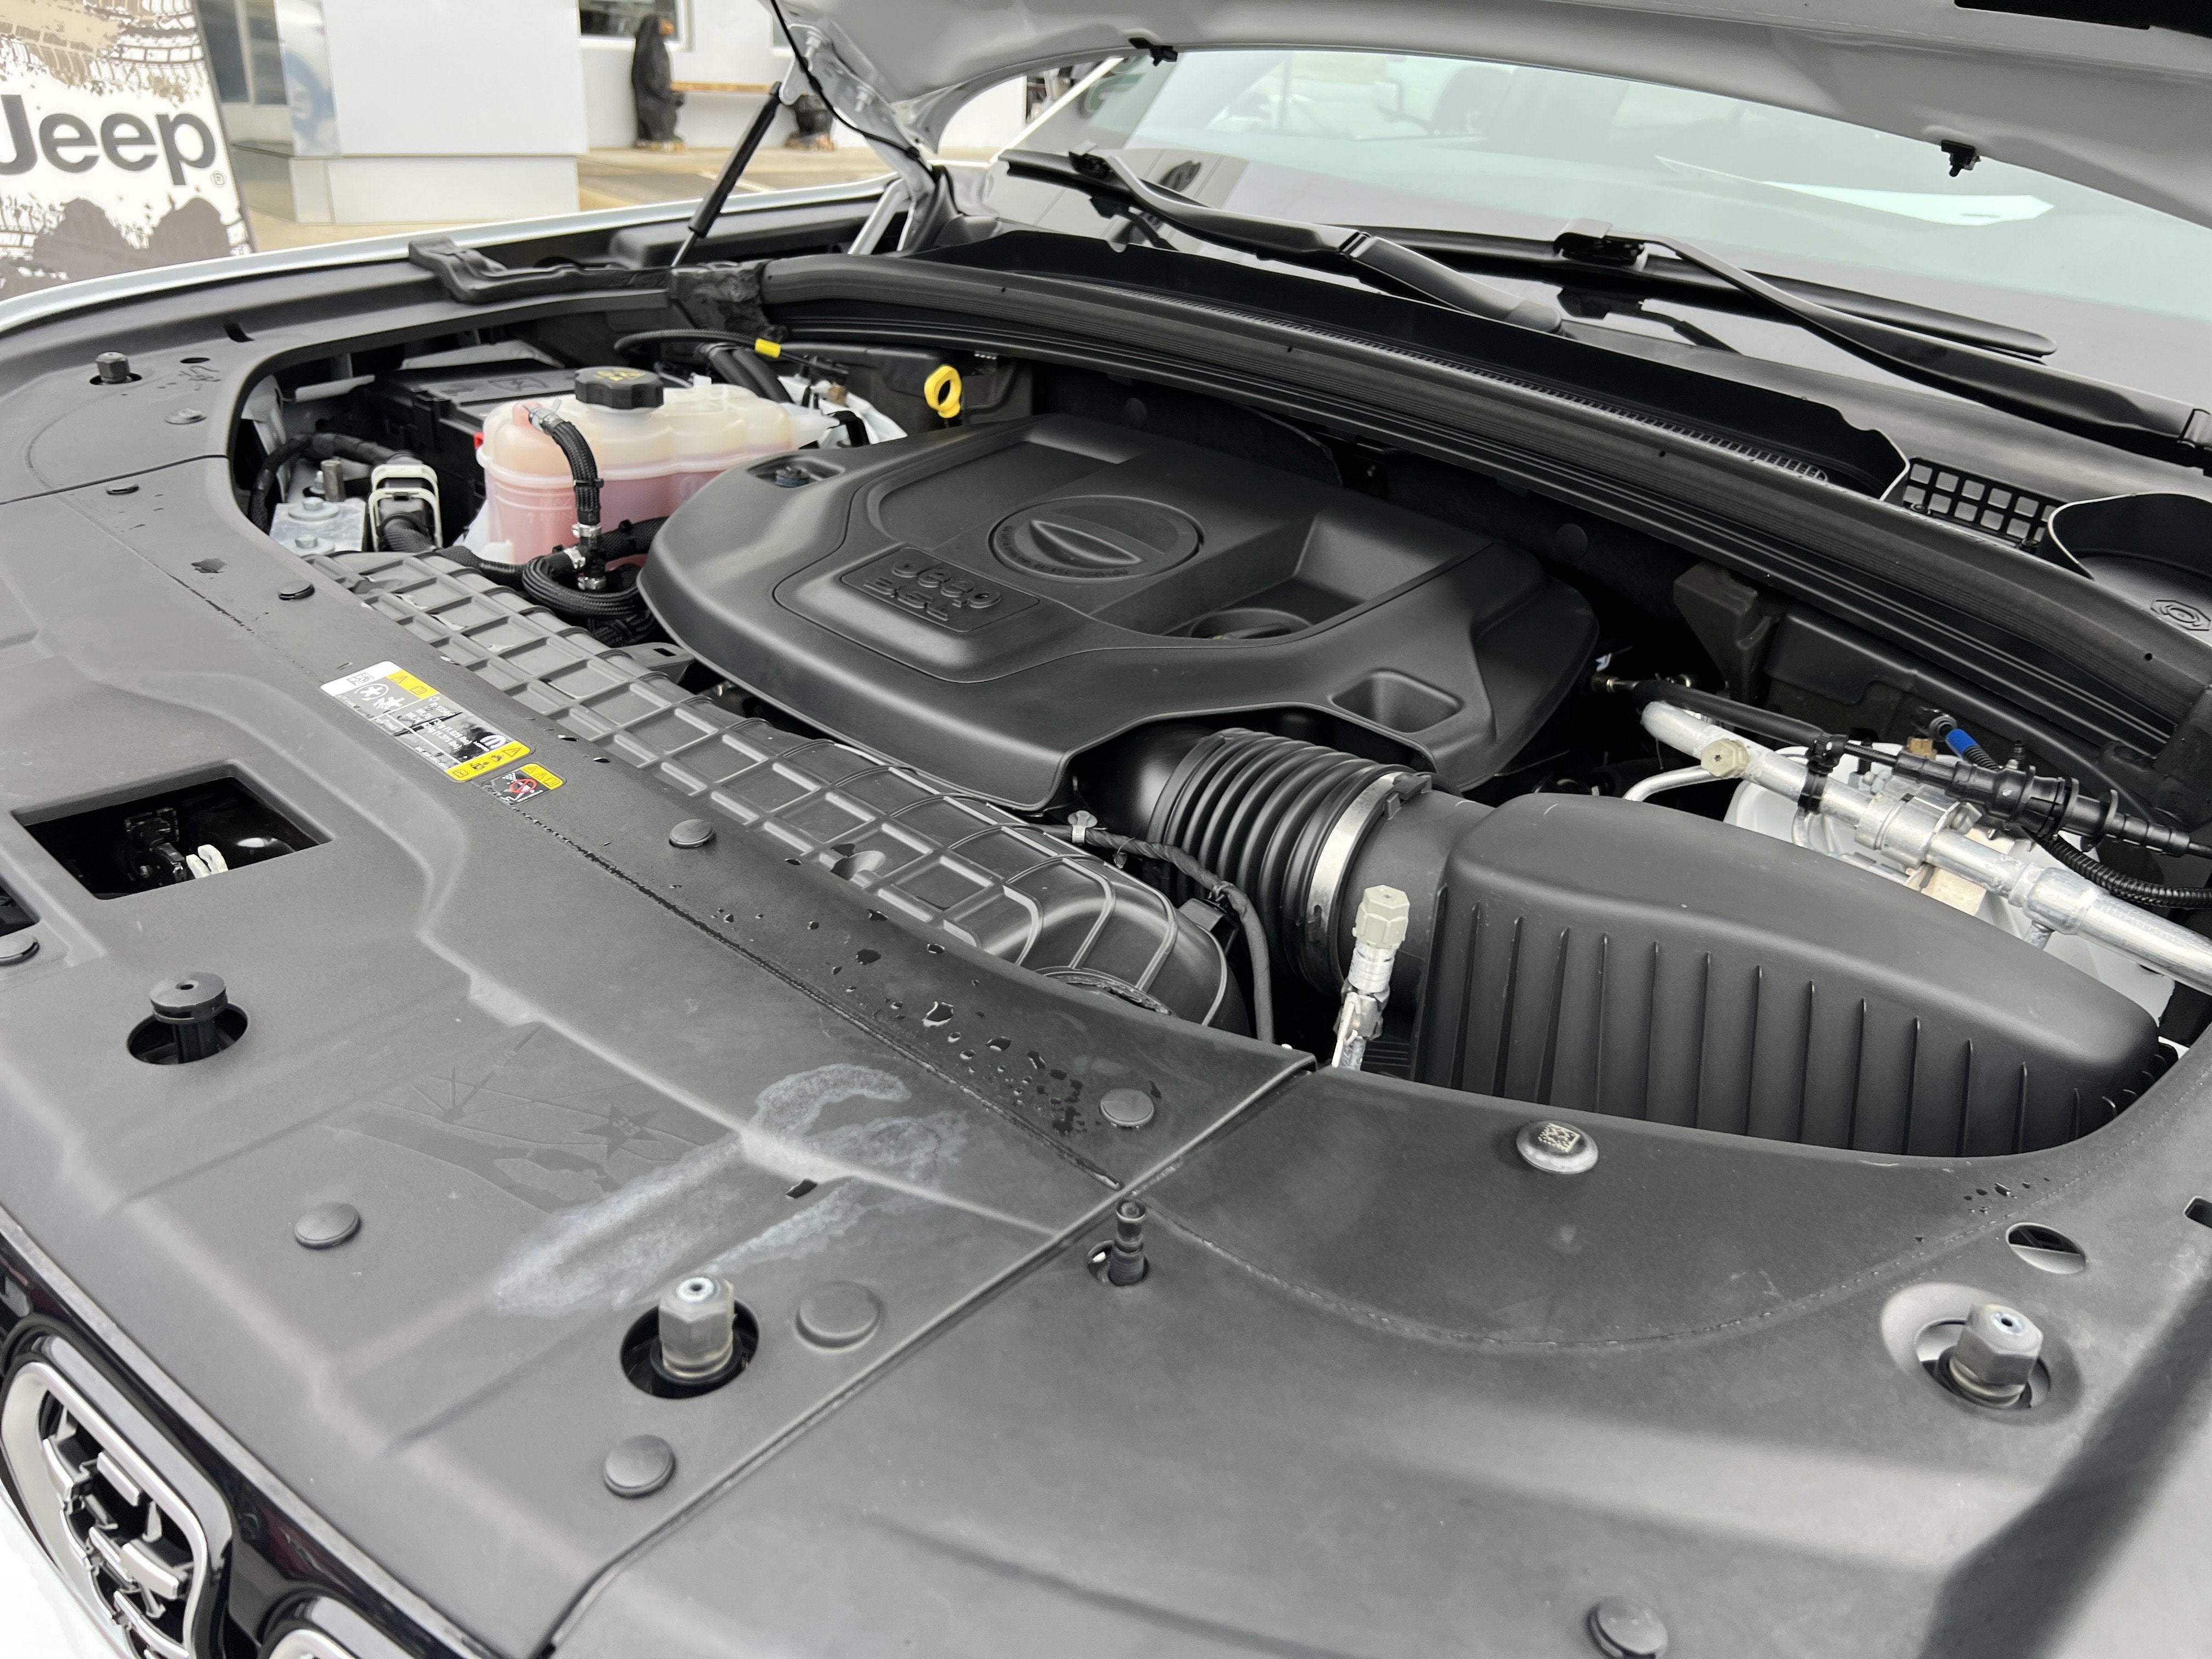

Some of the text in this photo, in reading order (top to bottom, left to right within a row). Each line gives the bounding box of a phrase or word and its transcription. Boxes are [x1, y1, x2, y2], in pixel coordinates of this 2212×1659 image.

[0, 94, 216, 186] Jeep
[863, 577, 950, 622] 3.6L
[891, 559, 1002, 609] Jeep
